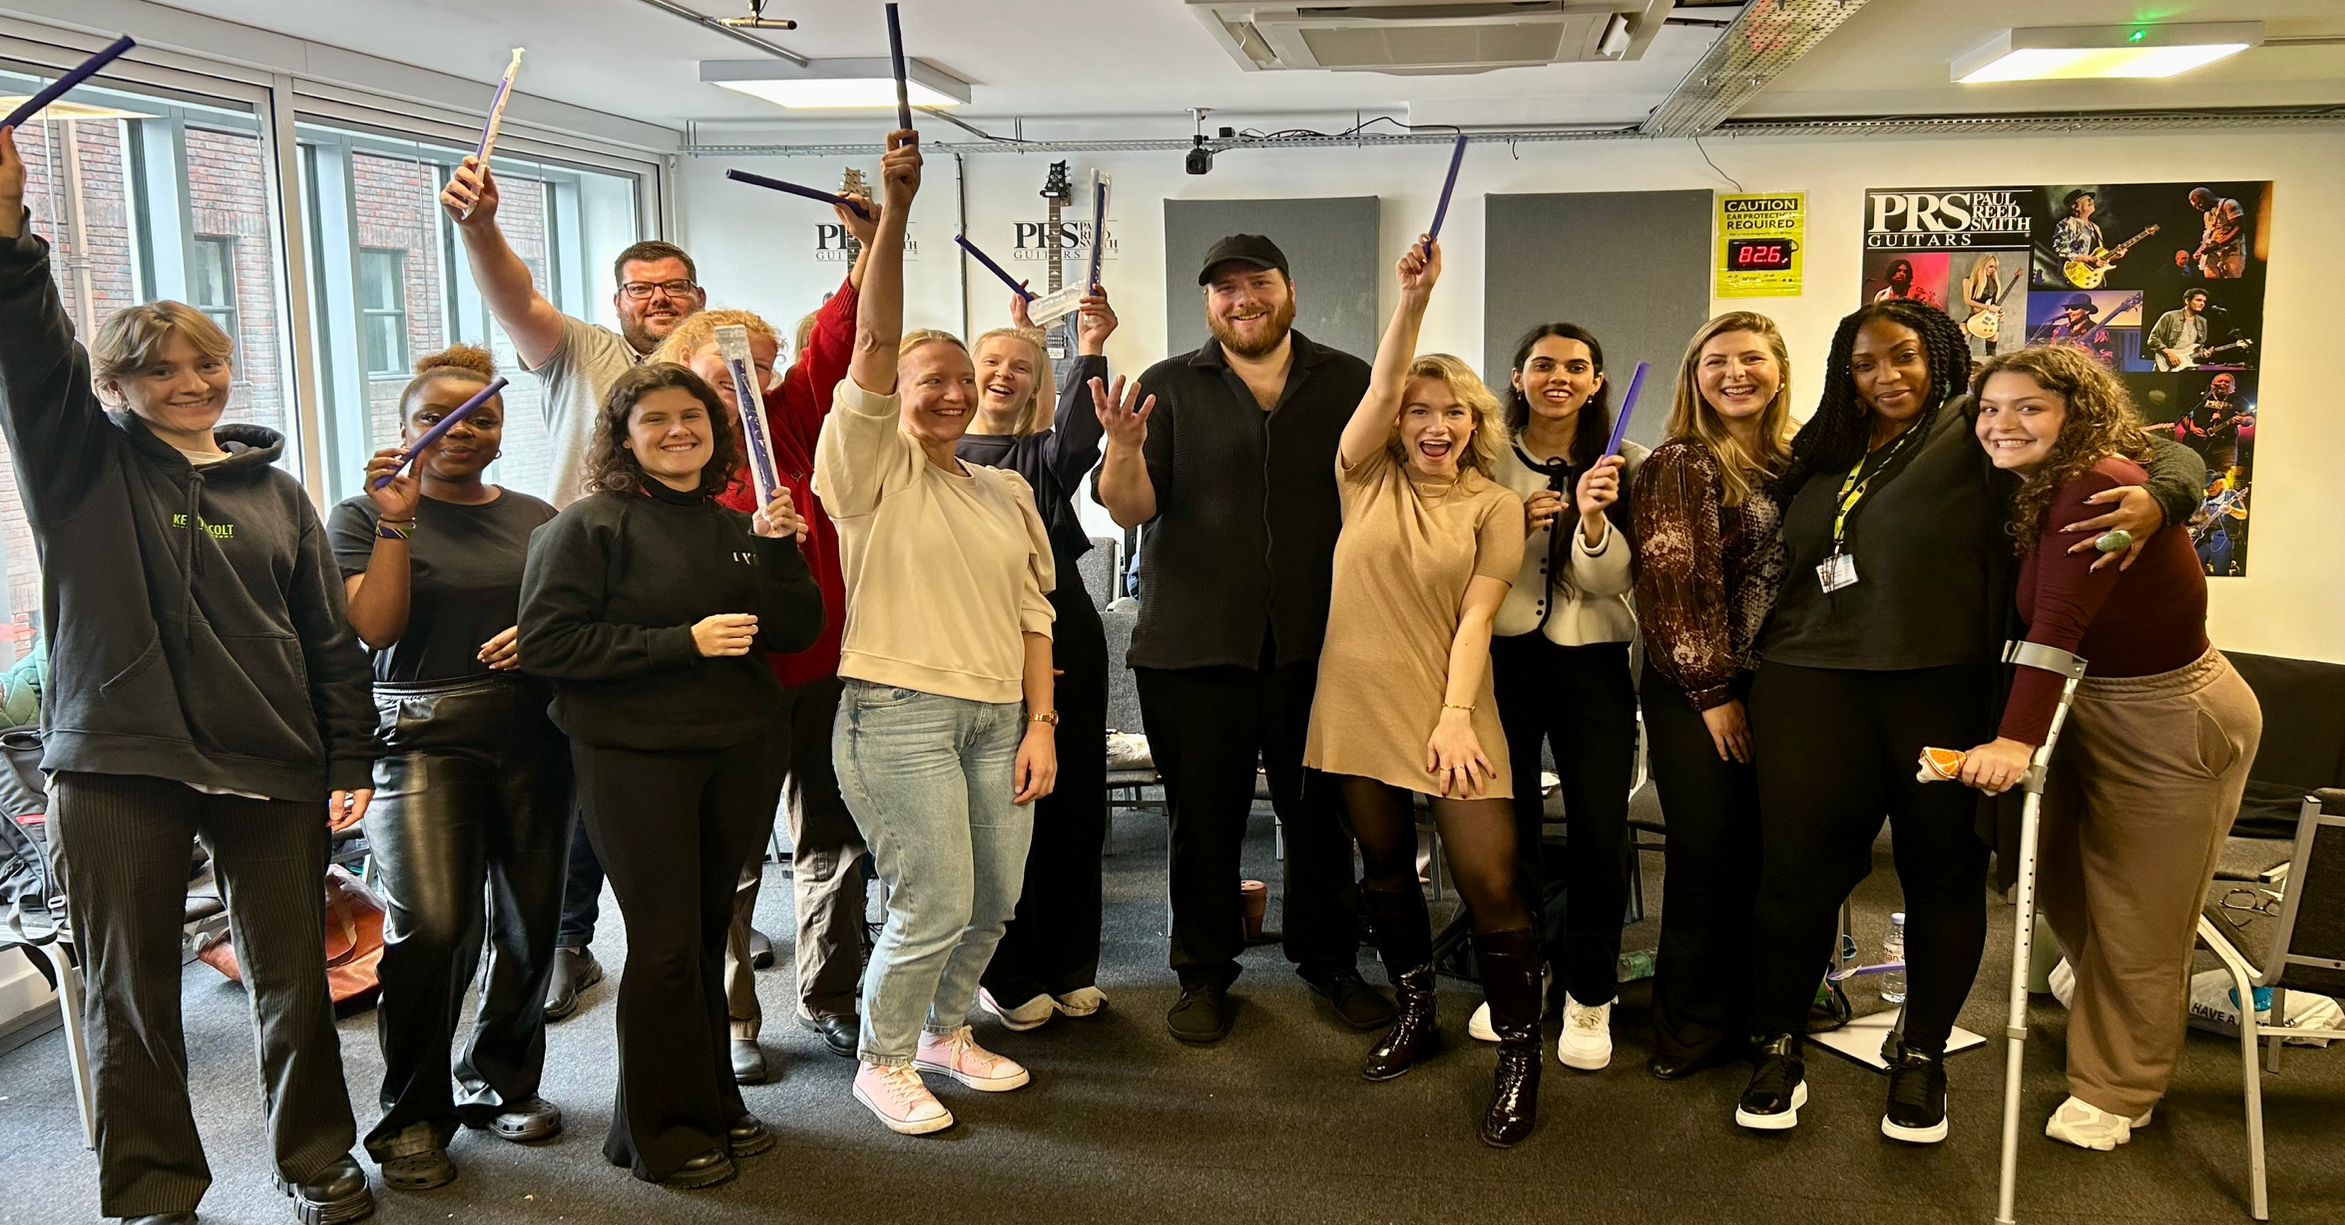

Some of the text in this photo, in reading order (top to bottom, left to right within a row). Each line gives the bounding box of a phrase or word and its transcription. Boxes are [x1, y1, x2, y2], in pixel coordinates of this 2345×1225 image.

[1727, 200, 1795, 211] CAUTION
[1973, 192, 2017, 206] PAUL
[1867, 193, 1972, 233] PRS
[1972, 205, 2021, 219] REED
[1727, 219, 1795, 230] REQUIRED
[1970, 217, 2032, 231] SMITH
[1867, 233, 1972, 247] GUITARS
[1013, 250, 1081, 259] GUITRS
[1738, 246, 1782, 262] 82.6
[208, 524, 234, 535] COLT
[2191, 1002, 2236, 1025] HAVE A
